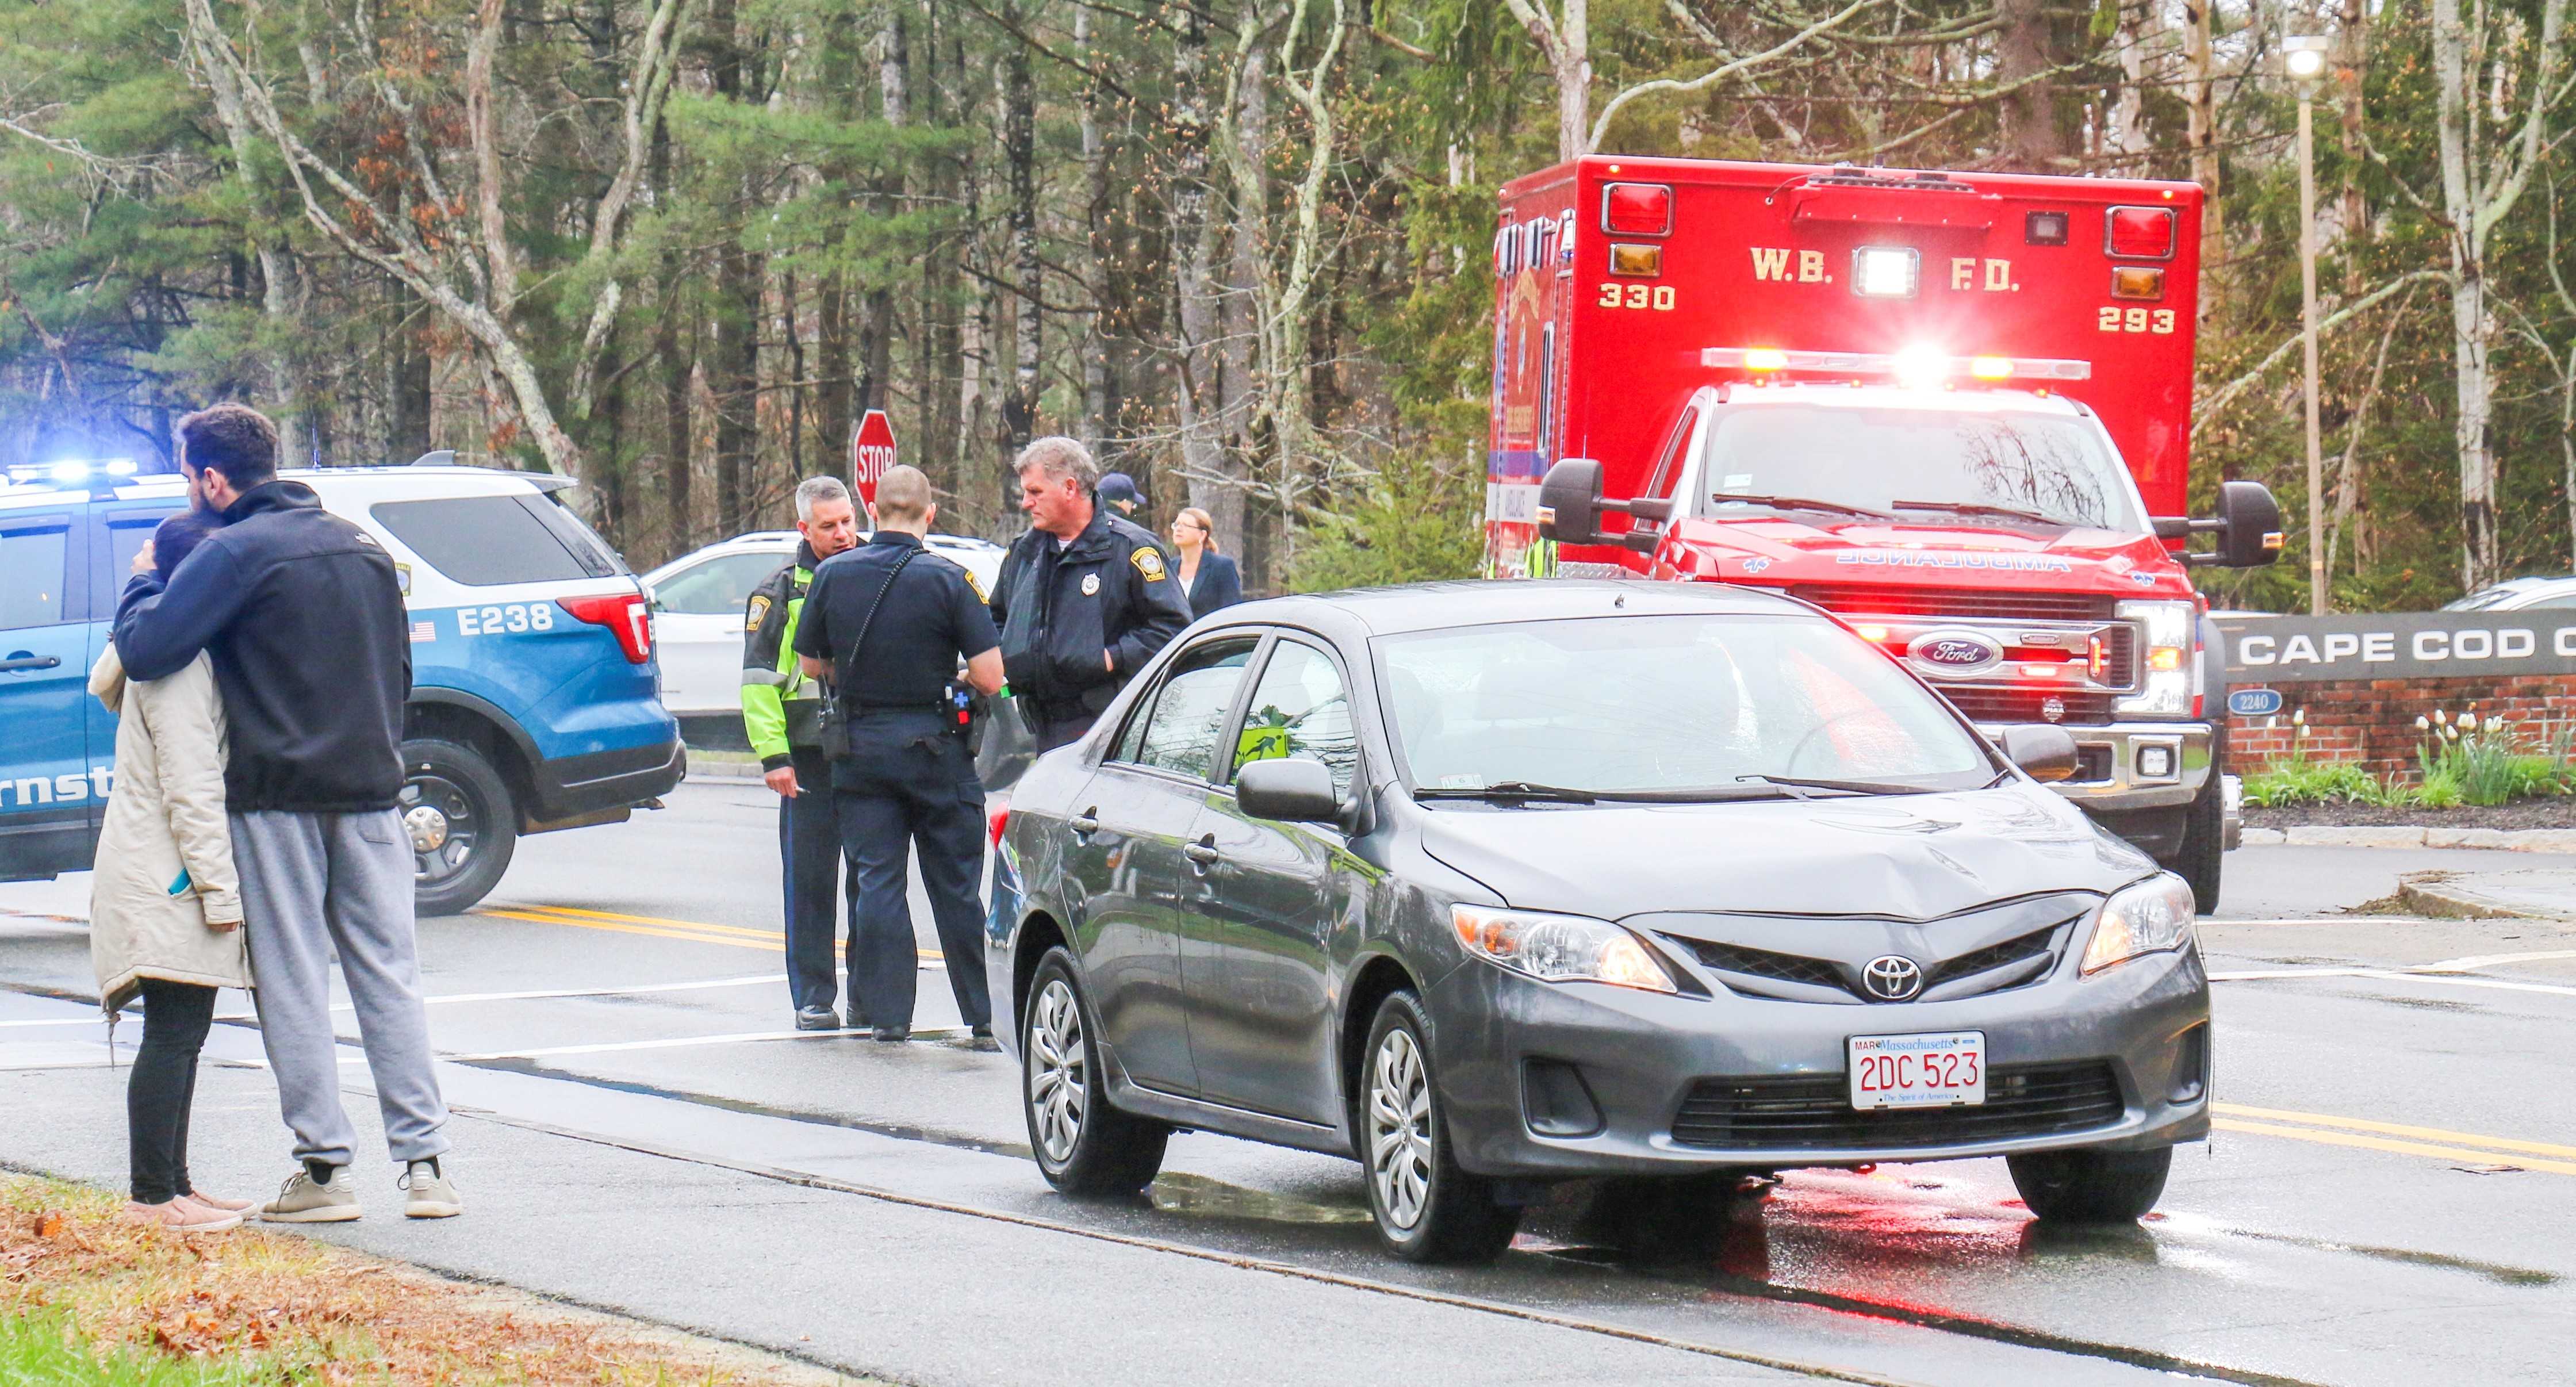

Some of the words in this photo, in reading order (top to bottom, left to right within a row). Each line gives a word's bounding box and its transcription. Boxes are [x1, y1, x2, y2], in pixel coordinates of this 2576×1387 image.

[1598, 282, 1676, 311] 330
[2099, 306, 2175, 334] 293
[858, 444, 894, 484] STOP
[457, 603, 553, 636] E238
[1933, 641, 1979, 661] Ford
[2240, 633, 2395, 665] CAPE
[2413, 629, 2536, 661] COD
[2241, 694, 2269, 709] 2240
[1855, 1041, 1875, 1051] MAR
[1880, 1039, 1953, 1052] Massachusetts
[1860, 1055, 1914, 1091] 2DC
[1924, 1052, 1978, 1088] 523
